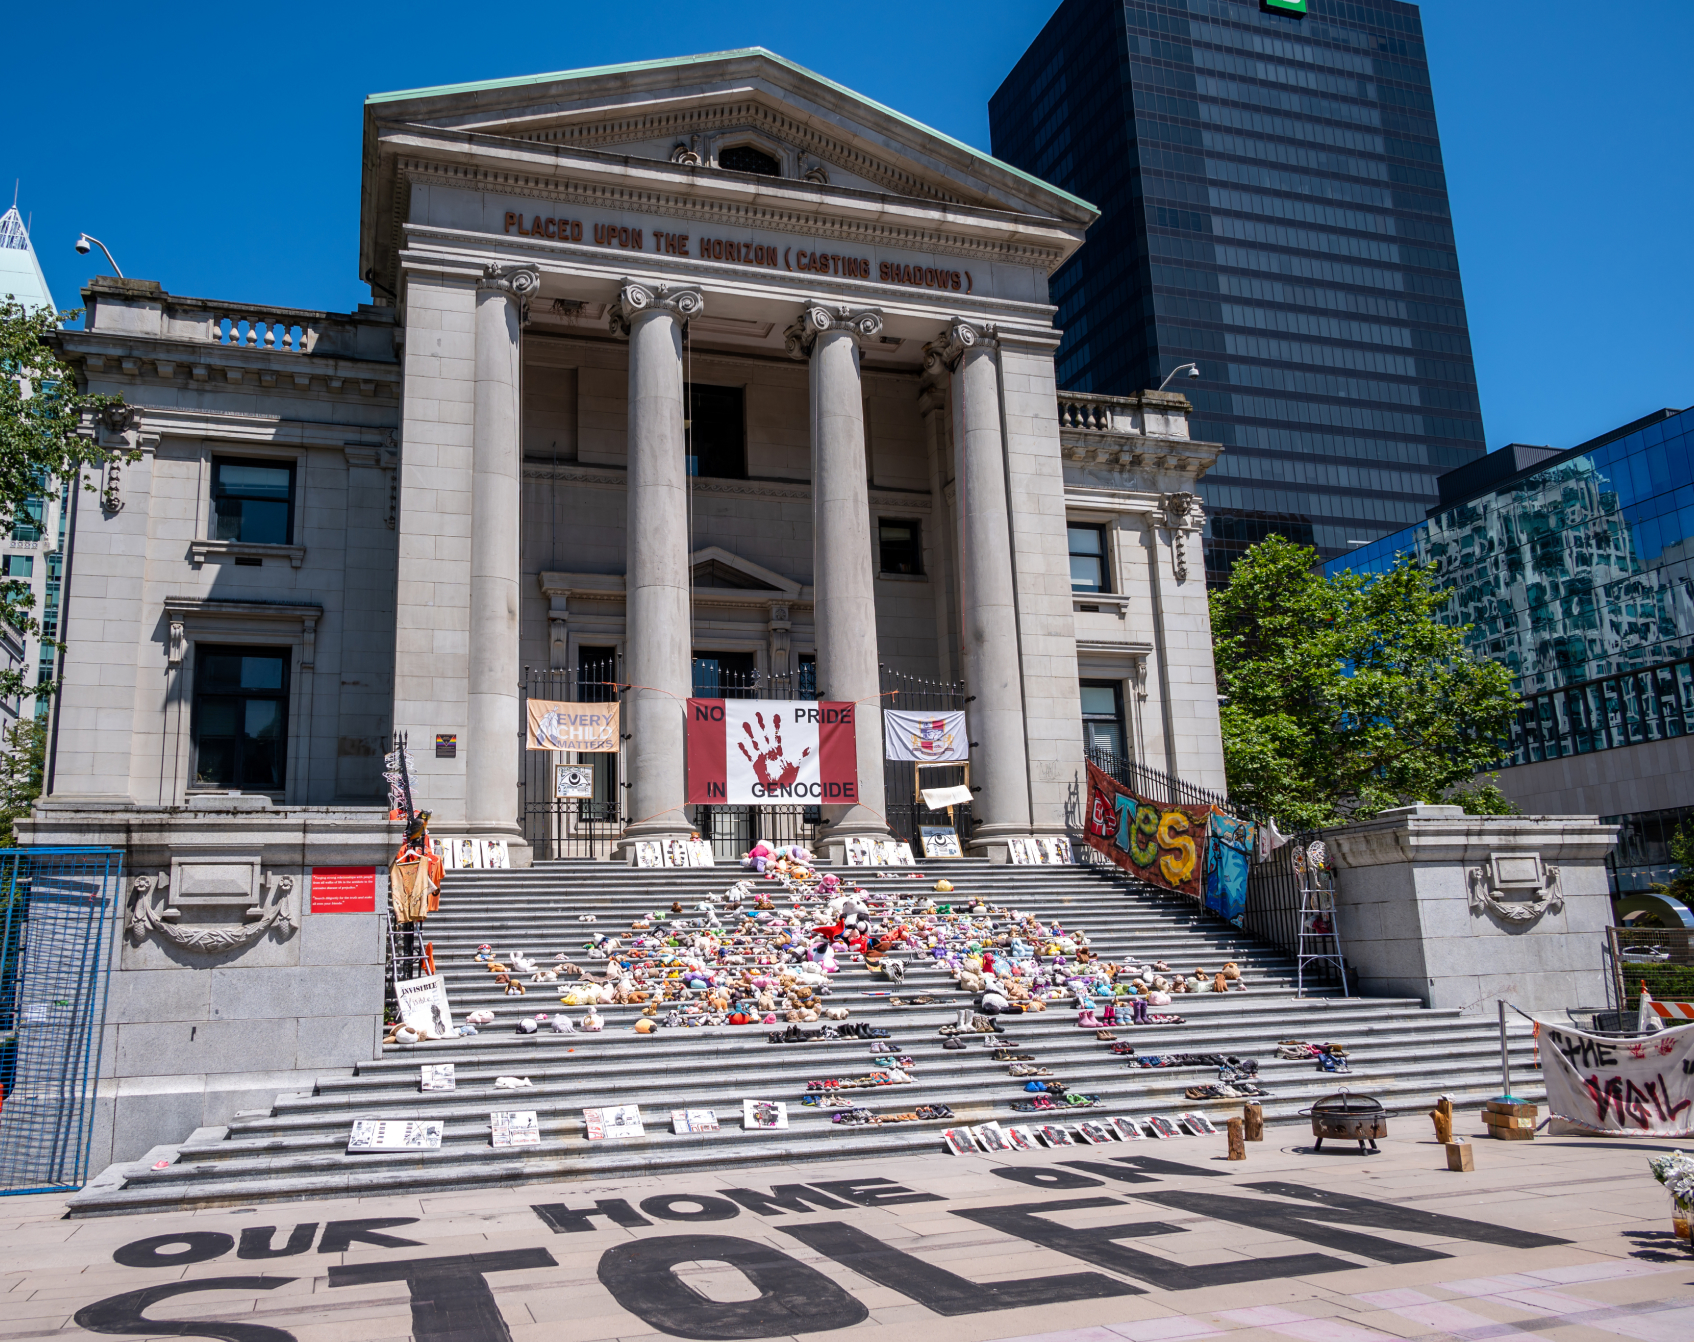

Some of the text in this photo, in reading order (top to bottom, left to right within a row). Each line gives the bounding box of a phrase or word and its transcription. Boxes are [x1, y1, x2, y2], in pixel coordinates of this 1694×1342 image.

[505, 211, 583, 242] PLACED
[594, 222, 643, 249] UPON
[653, 230, 689, 255] THE
[700, 237, 778, 267] HORIZON
[556, 712, 613, 727] EVERY
[695, 705, 852, 724] NO PRIDE
[557, 725, 613, 740] CHILD
[556, 739, 614, 750] MATTERS
[707, 782, 855, 798] IN GENOCIDE
[400, 981, 438, 998] INVISIBLE
[112, 1155, 1235, 1268] OUR HOME ON
[73, 1181, 1579, 1342] STOLEN
